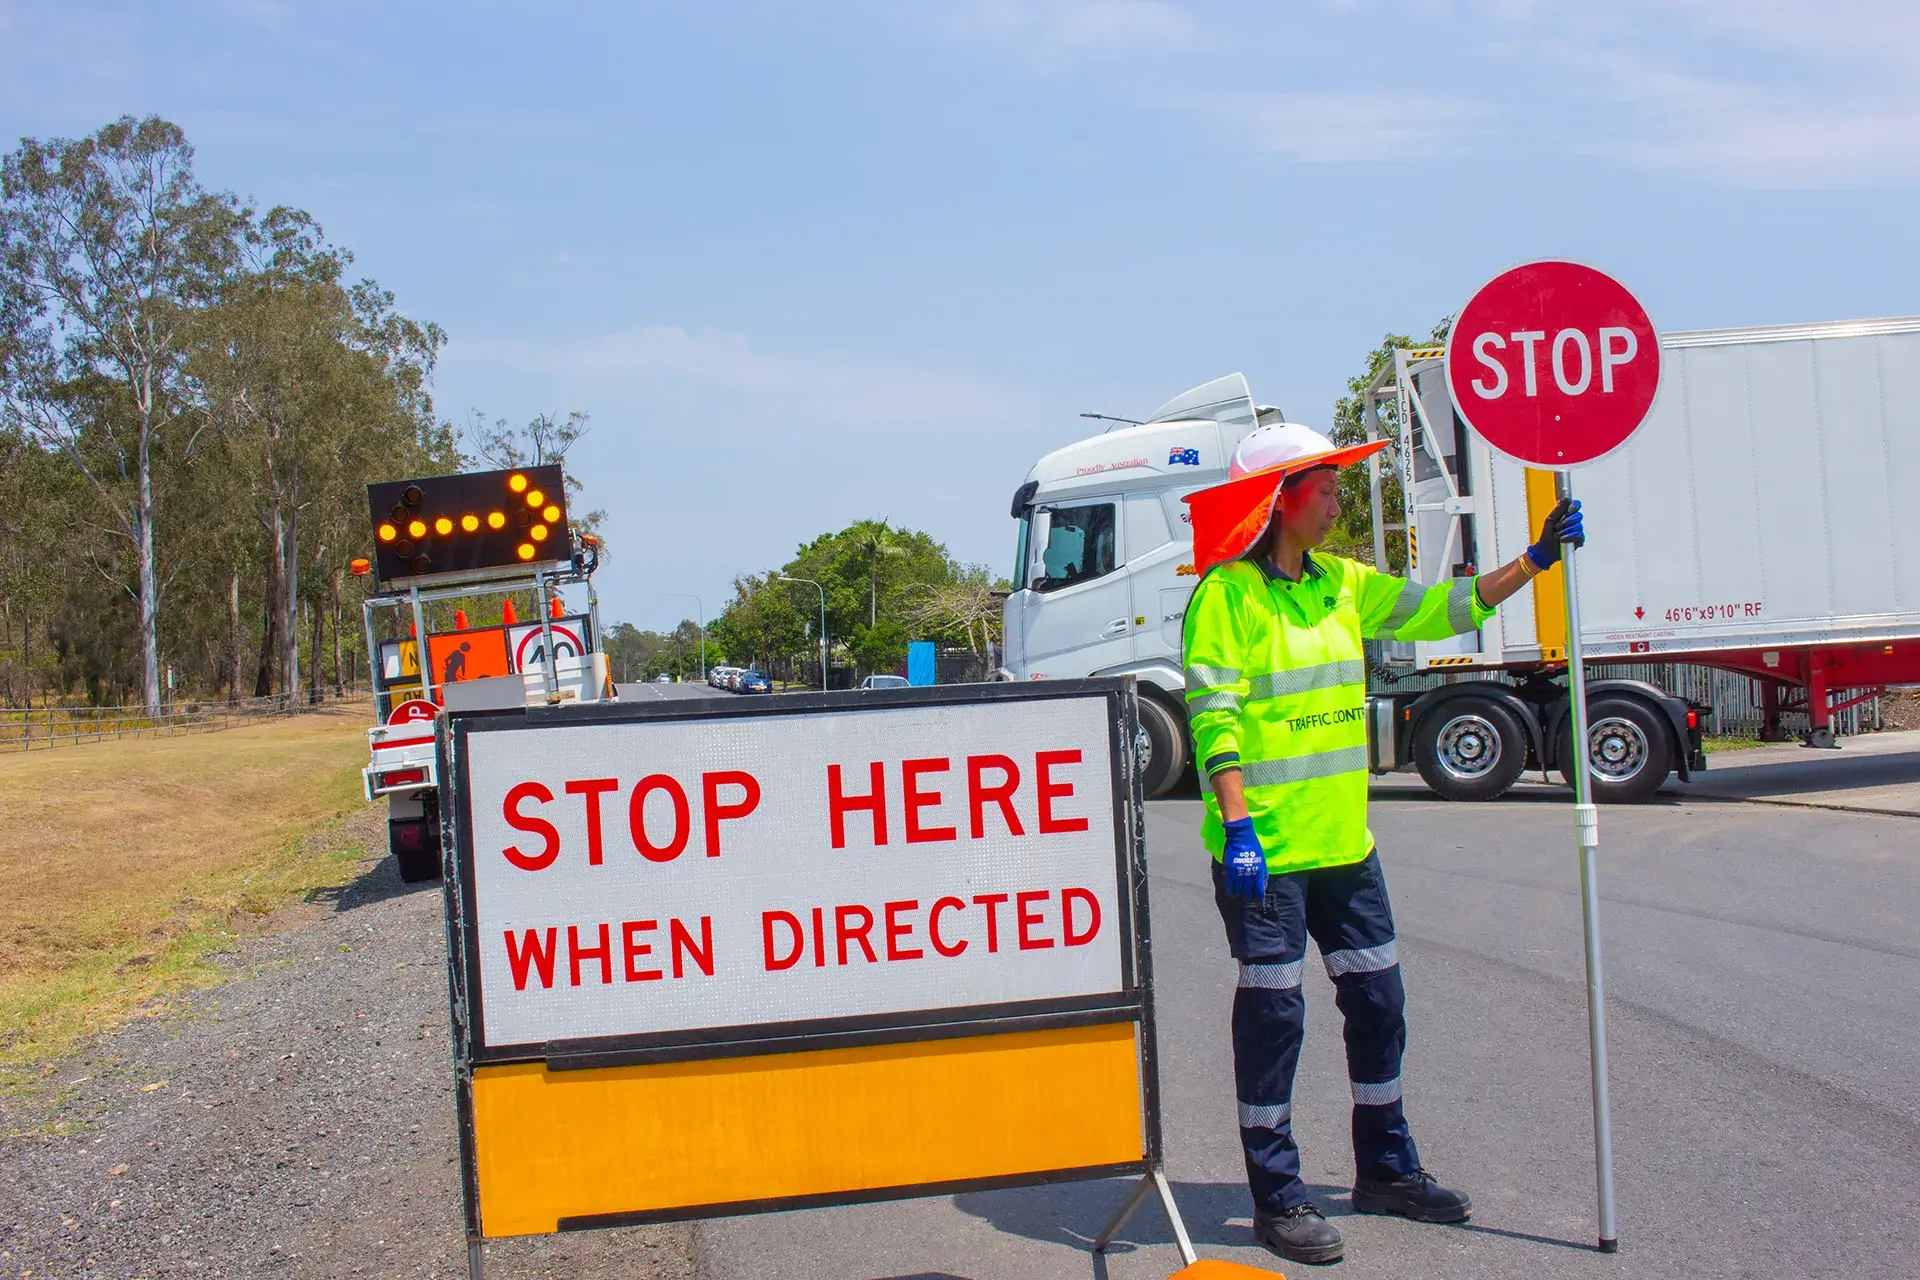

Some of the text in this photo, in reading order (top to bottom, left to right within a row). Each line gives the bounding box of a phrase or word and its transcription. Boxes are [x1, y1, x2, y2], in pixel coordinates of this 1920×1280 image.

[1471, 326, 1638, 400] STOP
[1076, 456, 1149, 475] Proudly Australian
[1403, 435, 1412, 482] 4625
[1744, 602, 1762, 617] RF
[1286, 712, 1332, 732] TRAFFIC
[501, 749, 1090, 872] STOP HERE
[503, 887, 1102, 992] WHEN DIRECTED
